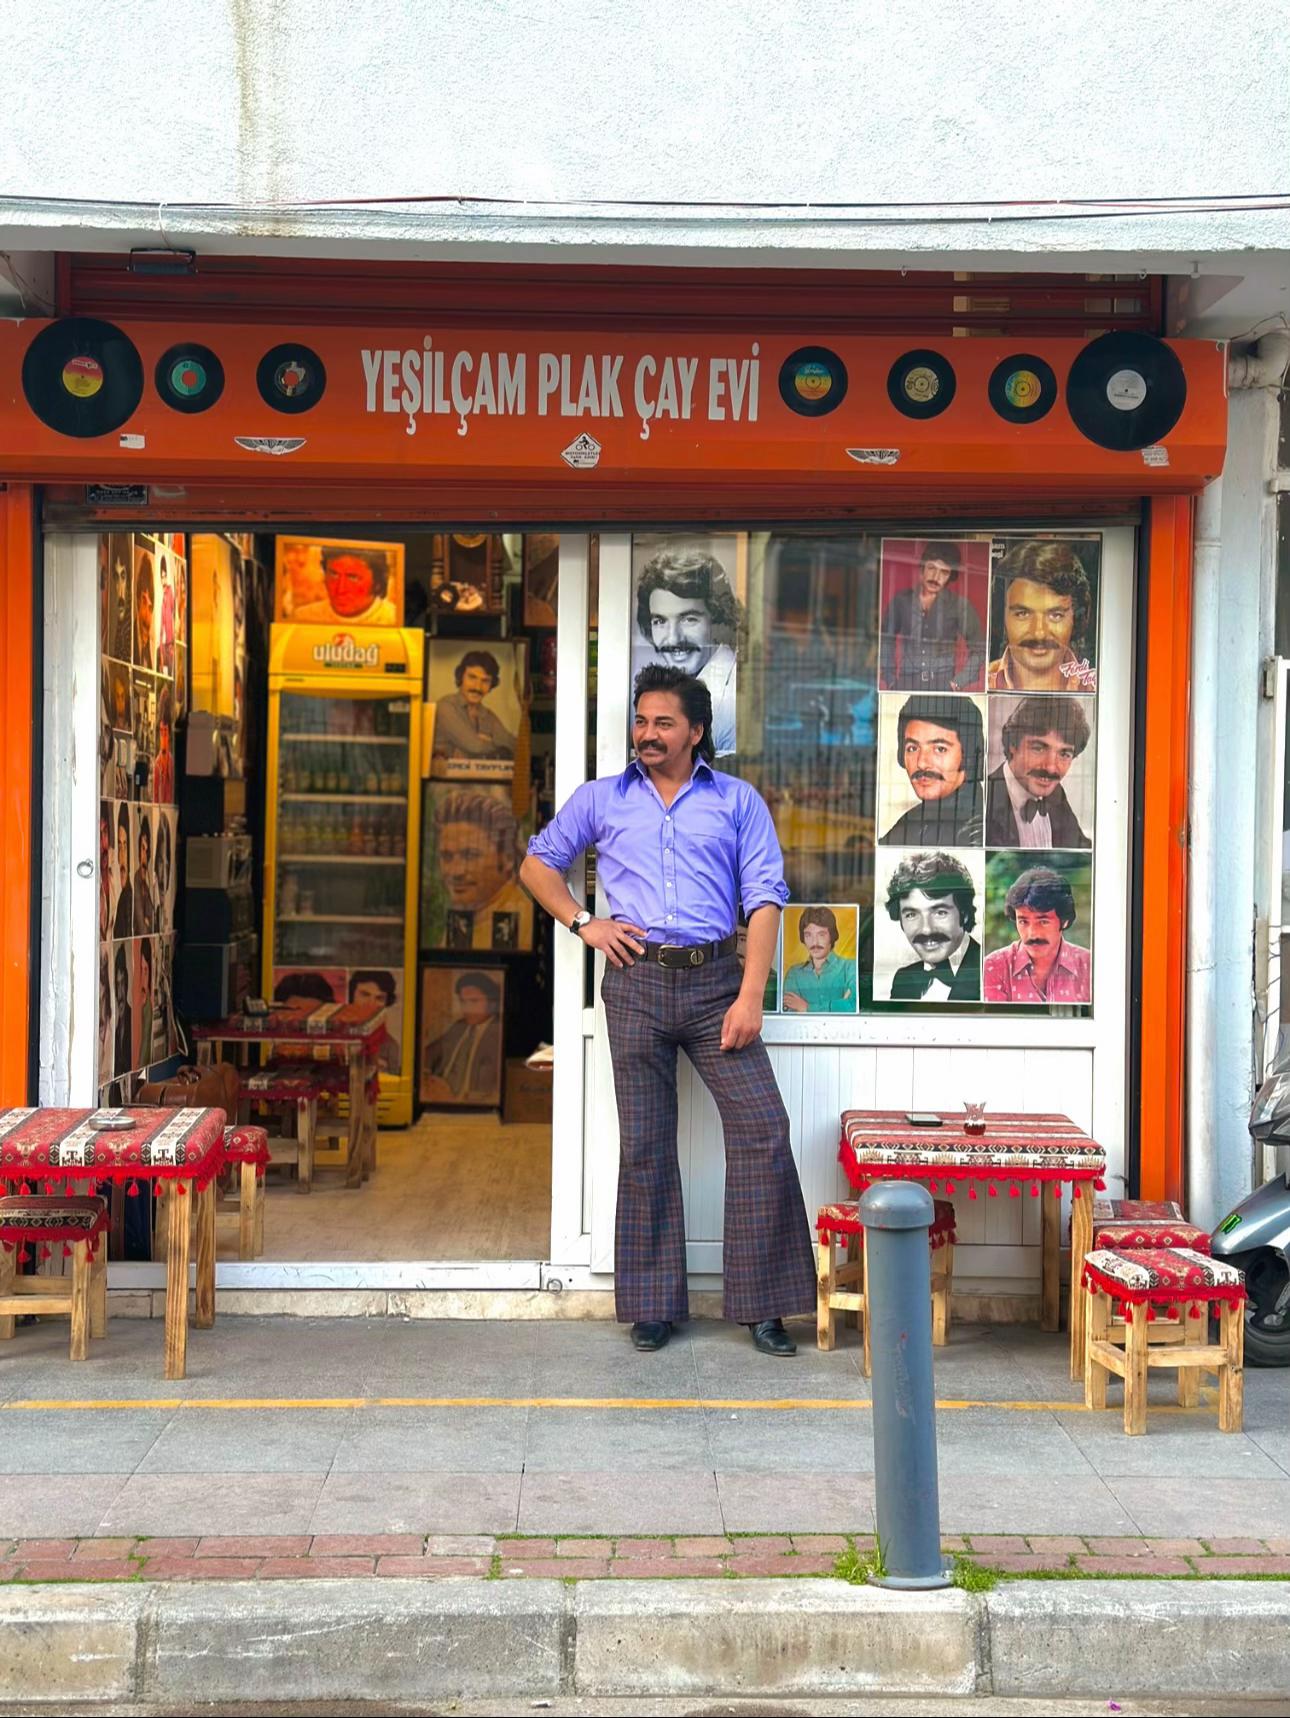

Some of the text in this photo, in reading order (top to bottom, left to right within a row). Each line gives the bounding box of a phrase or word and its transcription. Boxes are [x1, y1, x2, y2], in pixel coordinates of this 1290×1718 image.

[361, 335, 760, 440] YEŞİLÇAM PLAK ÇAY EVİ
[1058, 658, 1090, 678] Ferdi
